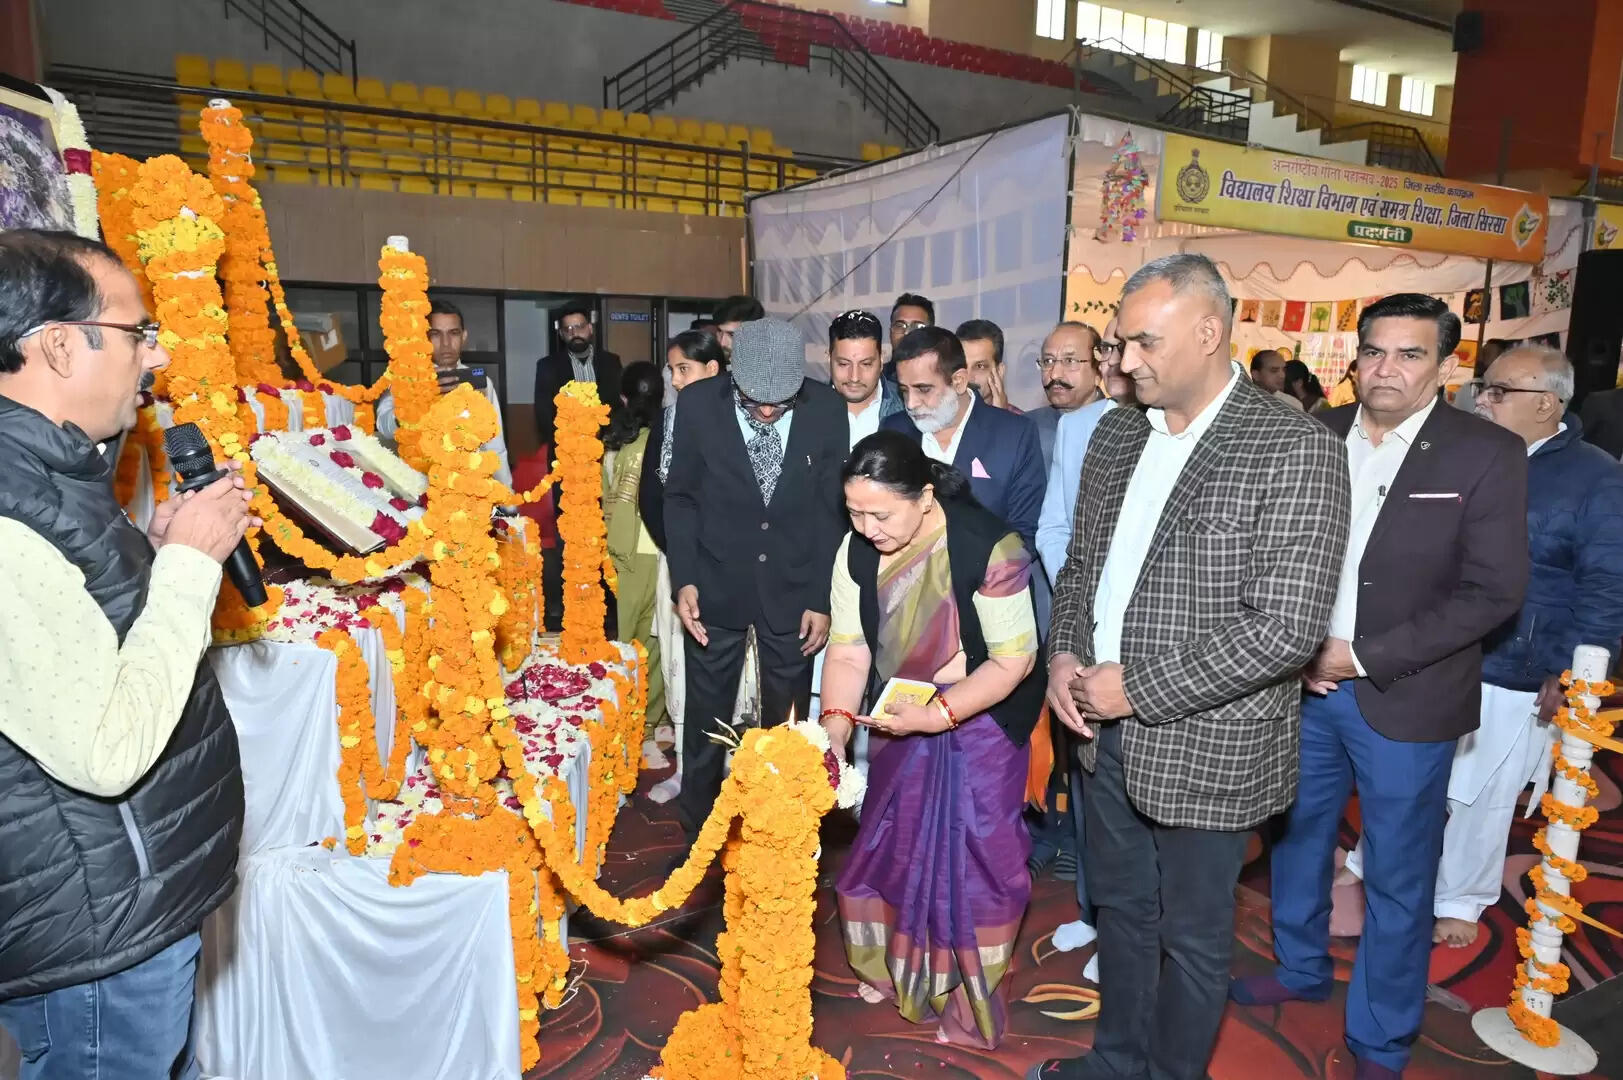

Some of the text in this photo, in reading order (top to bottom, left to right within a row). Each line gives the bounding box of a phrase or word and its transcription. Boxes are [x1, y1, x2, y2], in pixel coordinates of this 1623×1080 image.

[1404, 177, 1422, 192] जिला
[1219, 170, 1507, 234] विद्यालय शिक्षा विभाग एवं समग्र शिक्षा, जिला सिरसा
[1353, 224, 1407, 242] प्रदर्शनी
[610, 312, 649, 321] GENTS TOILET
